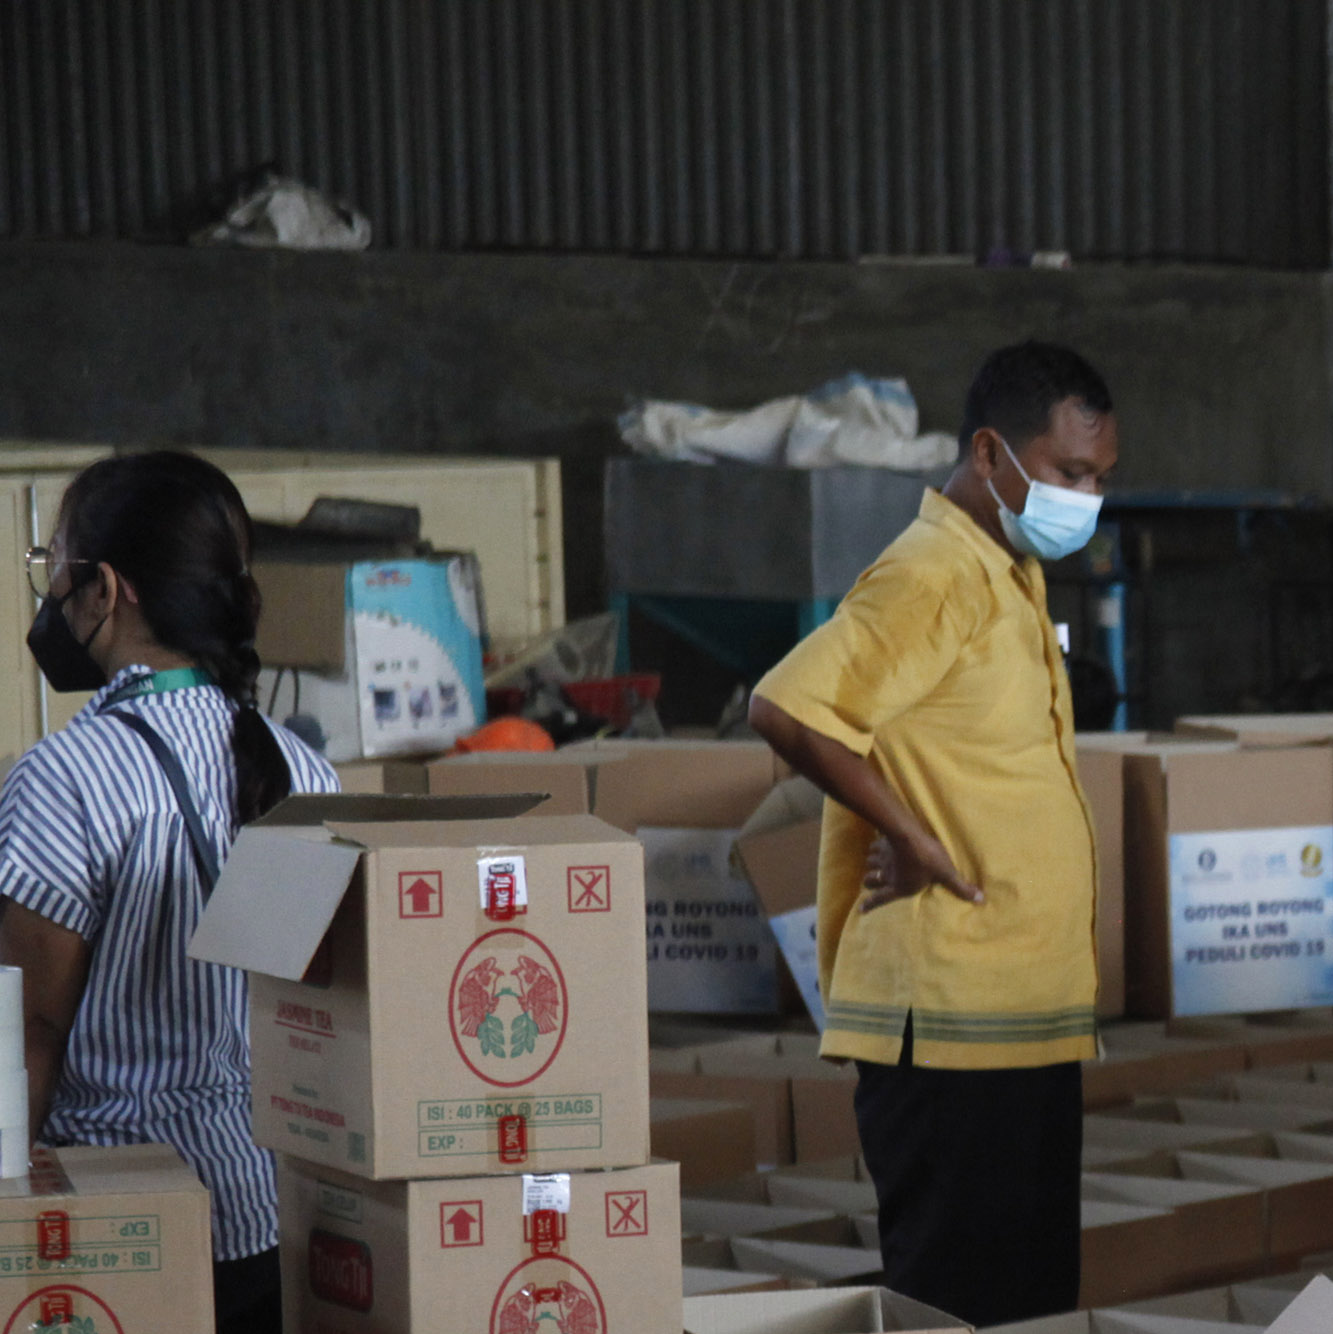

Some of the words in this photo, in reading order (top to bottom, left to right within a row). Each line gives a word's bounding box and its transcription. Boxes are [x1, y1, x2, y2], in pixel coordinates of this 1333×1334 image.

[673, 901, 759, 918] ROYONG
[1183, 902, 1252, 923] GOTONG
[1256, 898, 1325, 916] ROYONG
[671, 922, 713, 940] UNS
[1221, 923, 1250, 941] IKA
[1254, 920, 1289, 938] UNS
[665, 944, 728, 962] COVID
[1184, 945, 1247, 964] PEDULI
[1250, 940, 1301, 960] COVID
[1305, 939, 1325, 957] 19
[427, 1105, 445, 1121] ISI
[456, 1104, 473, 1119] 40
[475, 1102, 513, 1118] PACK
[535, 1101, 551, 1117] 25
[553, 1099, 594, 1116] BAGS
[427, 1135, 457, 1151] EXP
[119, 1220, 150, 1237] EXP
[102, 1252, 120, 1268] 40
[131, 1251, 151, 1267] ISI
